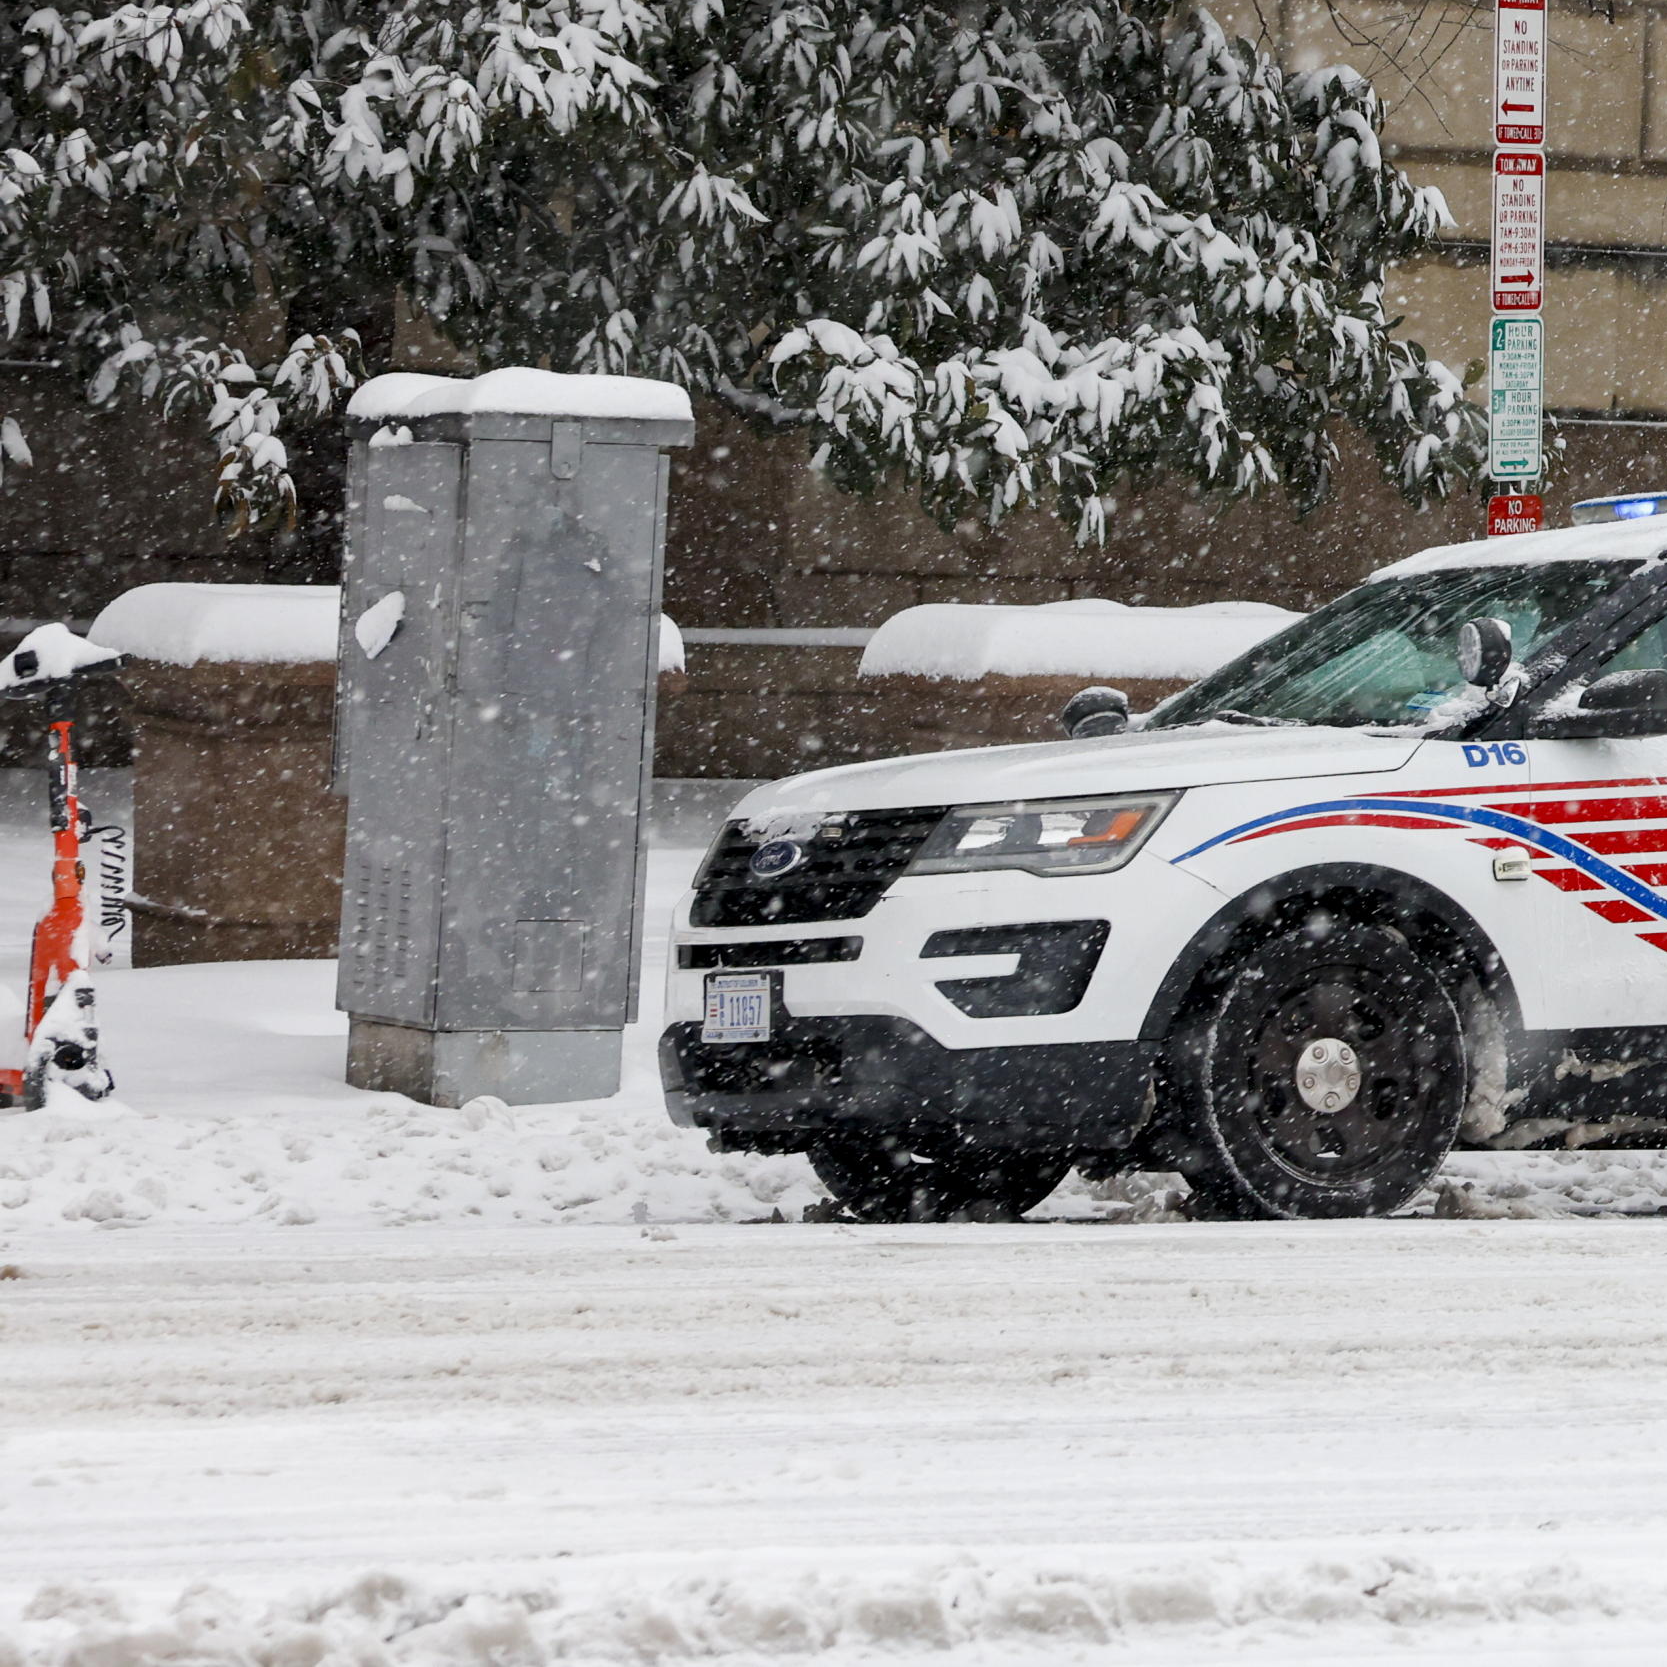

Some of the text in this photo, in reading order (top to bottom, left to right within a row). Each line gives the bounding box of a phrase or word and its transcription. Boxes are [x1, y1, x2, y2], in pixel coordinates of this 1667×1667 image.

[1514, 20, 1527, 35] NO
[1503, 39, 1539, 55] STANDING
[1502, 58, 1539, 72] OR PARKING
[1506, 76, 1535, 92] ANYTIME
[1500, 158, 1537, 172] TOW AWAY
[1513, 179, 1525, 192] NO
[1501, 194, 1536, 207] STANDING
[1499, 210, 1538, 223] OR PARKING
[1500, 227, 1537, 238] 7AM-9:30AM
[1500, 242, 1536, 254] 4PM-6:30PM
[1496, 325, 1533, 349] 2 HOUR
[1508, 339, 1538, 351] PARKING
[1511, 392, 1532, 403] HOUR
[1508, 405, 1538, 415] PARKING
[1508, 500, 1523, 515] NO
[1494, 517, 1536, 533] PARKING
[1461, 742, 1526, 767] D16
